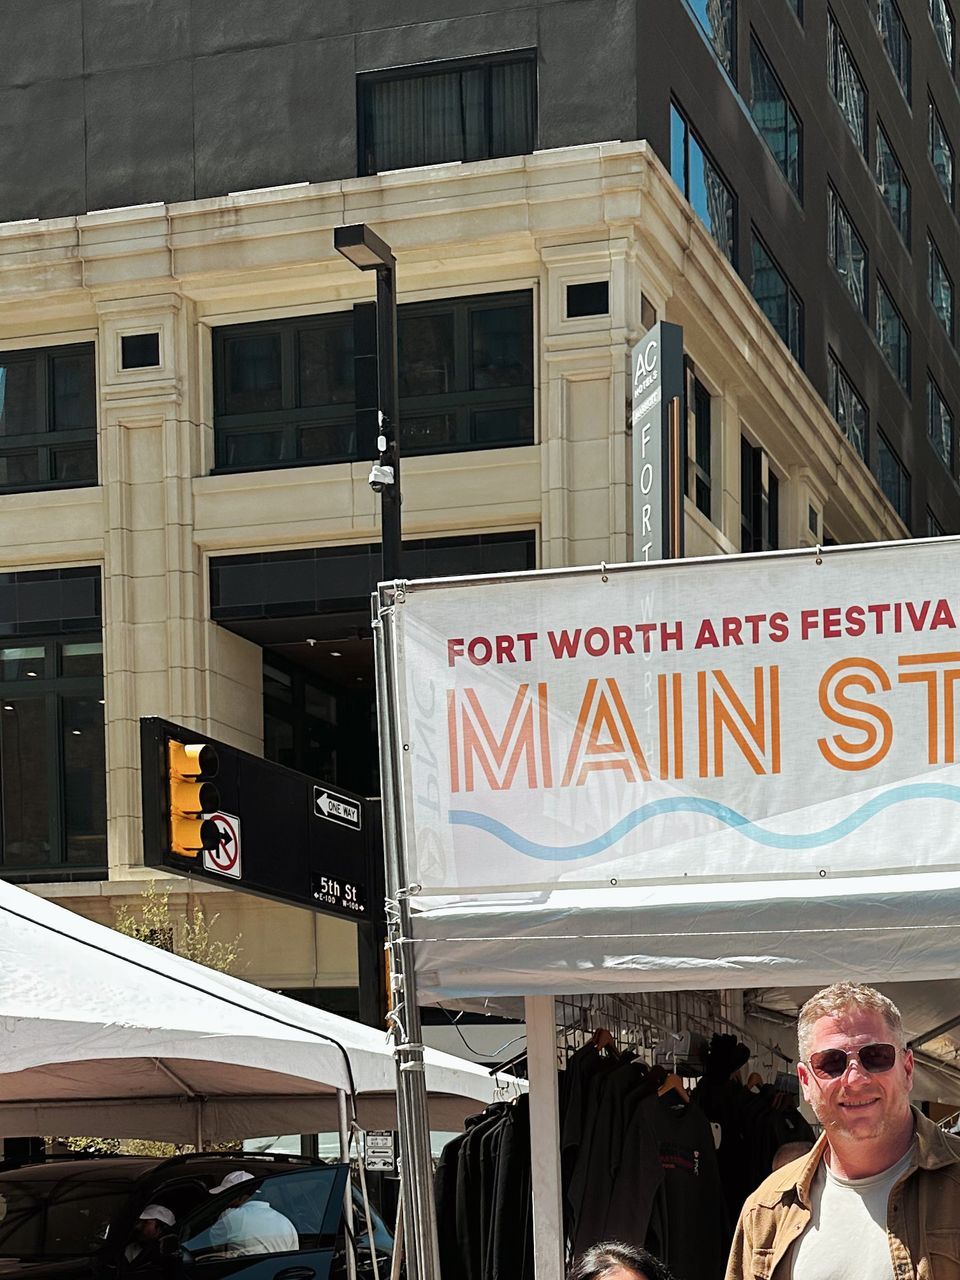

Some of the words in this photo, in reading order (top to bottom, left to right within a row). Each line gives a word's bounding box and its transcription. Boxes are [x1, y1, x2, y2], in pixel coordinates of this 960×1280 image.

[634, 340, 657, 385] AC
[634, 369, 658, 398] HOTELS
[447, 633, 538, 667] FORT
[547, 621, 683, 660] WORTH
[695, 612, 790, 649] ARTS
[446, 665, 781, 793] MAIN
[328, 800, 341, 815] ONE
[343, 806, 356, 820] WAY
[320, 877, 340, 896] 5th
[345, 884, 357, 902] St
